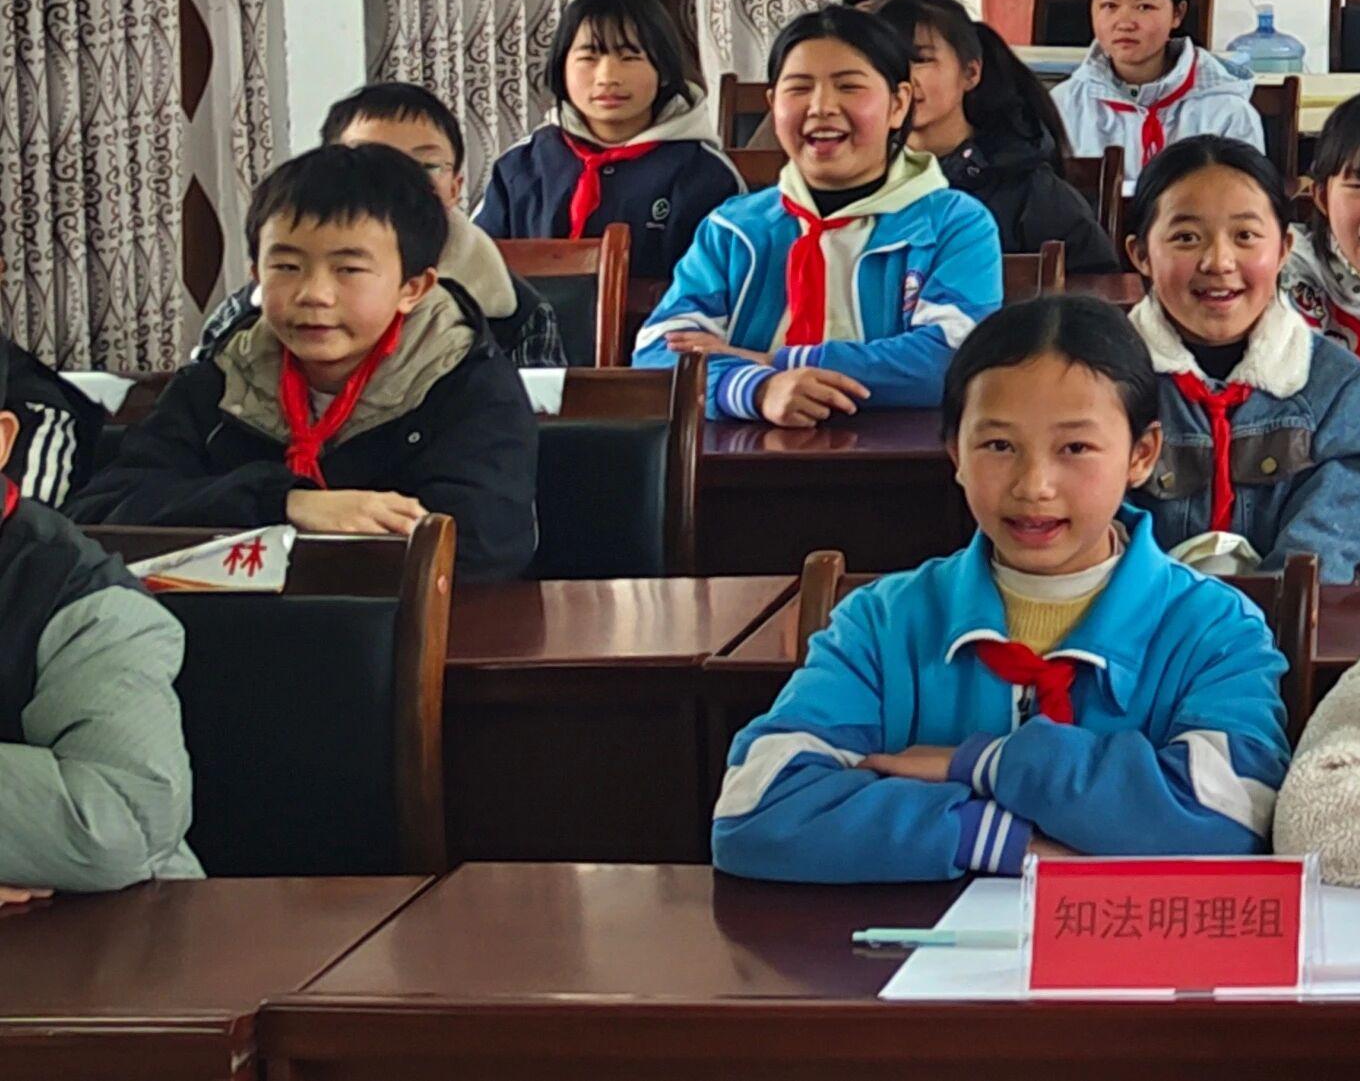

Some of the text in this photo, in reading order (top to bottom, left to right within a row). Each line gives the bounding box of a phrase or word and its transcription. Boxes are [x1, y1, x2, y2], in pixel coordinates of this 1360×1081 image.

[1054, 895, 1284, 940] 知法明理组
